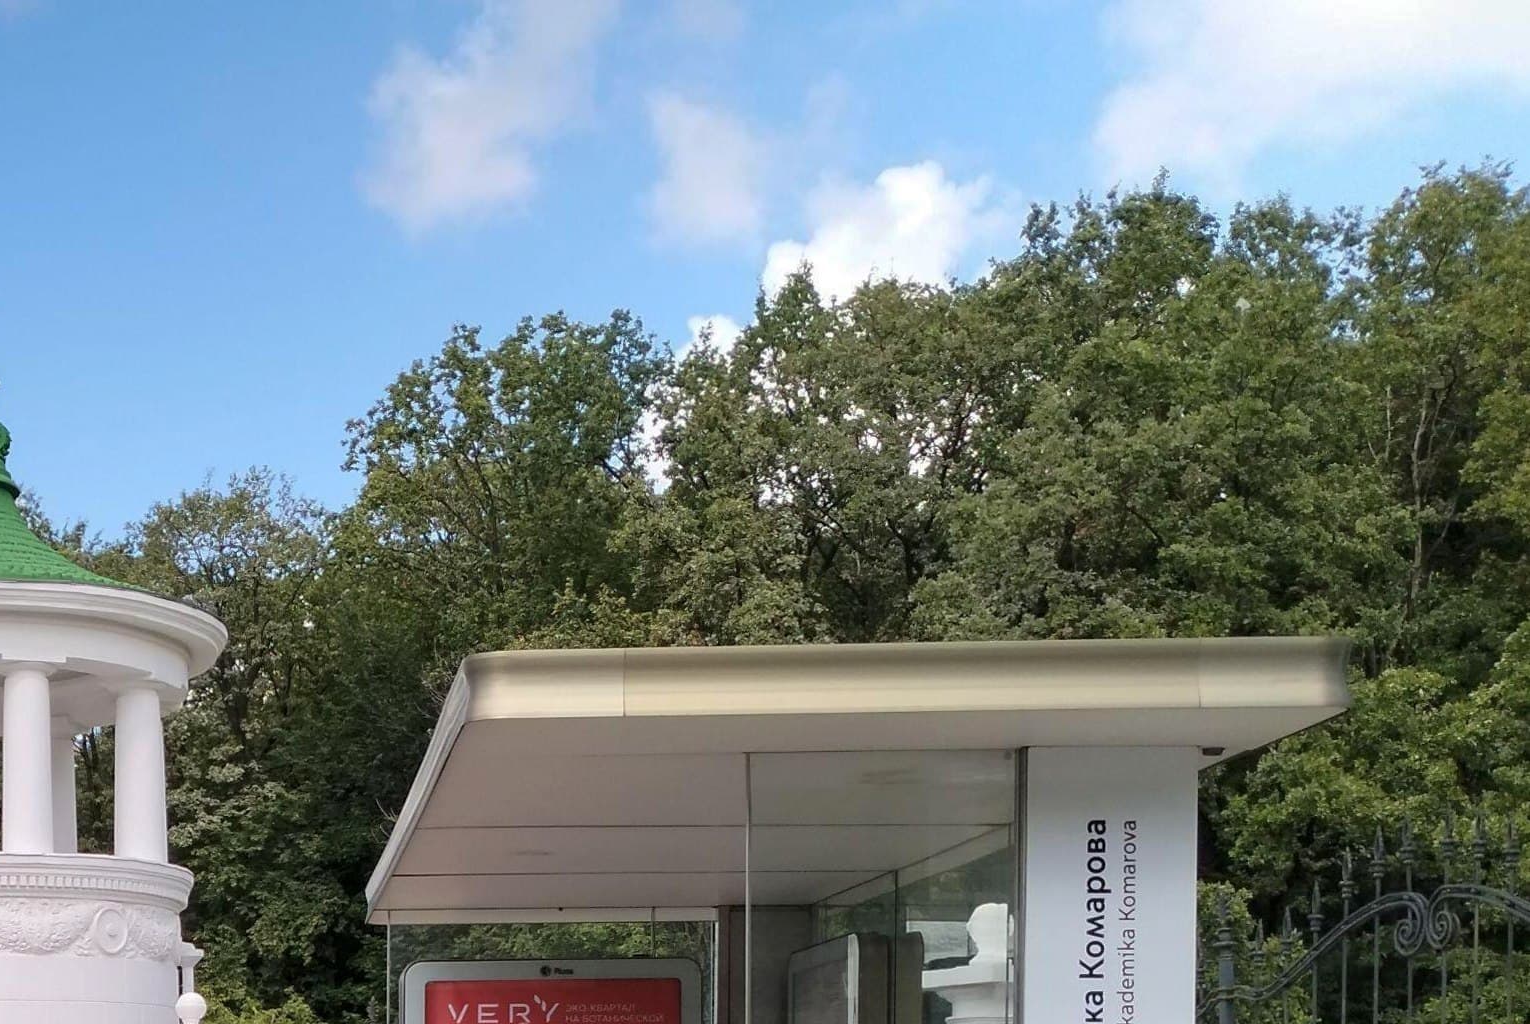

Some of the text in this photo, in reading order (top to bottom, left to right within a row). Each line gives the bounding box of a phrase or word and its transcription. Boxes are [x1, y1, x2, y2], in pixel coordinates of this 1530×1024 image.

[1078, 818, 1112, 979] Комарова
[1118, 819, 1137, 921] Komarova
[448, 995, 559, 1024] VERY
